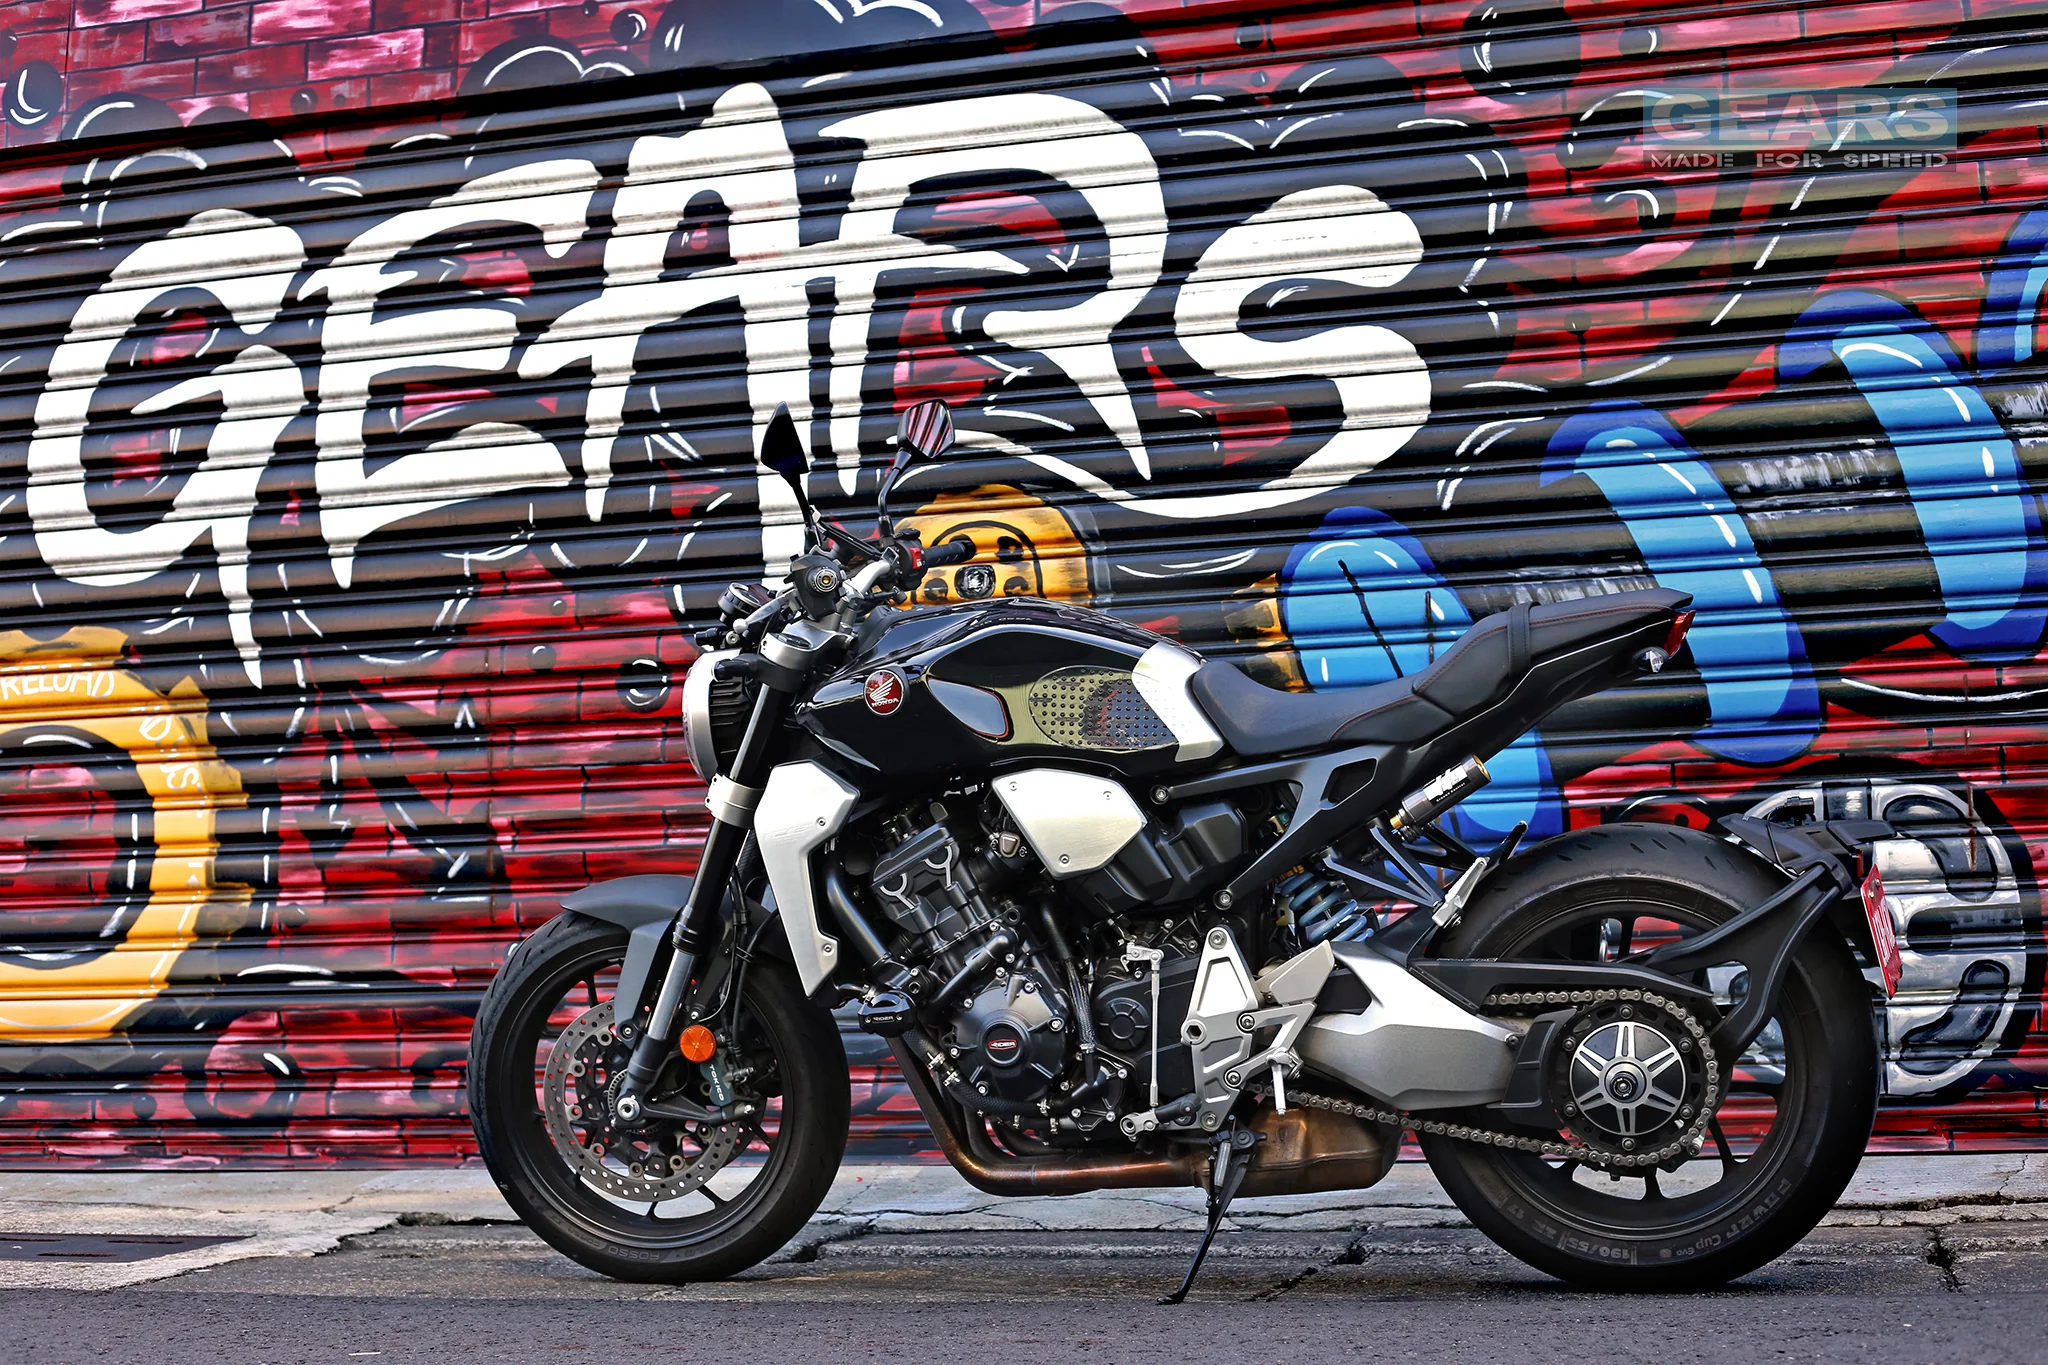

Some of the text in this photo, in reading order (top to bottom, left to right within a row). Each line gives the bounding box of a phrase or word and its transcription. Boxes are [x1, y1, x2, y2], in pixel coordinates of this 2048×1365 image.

[0, 662, 115, 700] RELOAD
[871, 698, 899, 707] HONDA
[709, 1064, 725, 1101] TOKICO
[1566, 1236, 1631, 1260] 190/55
[1696, 1233, 1722, 1251] Cup
[608, 1246, 661, 1261] ROSSO
[1676, 1248, 1695, 1257] Evo
